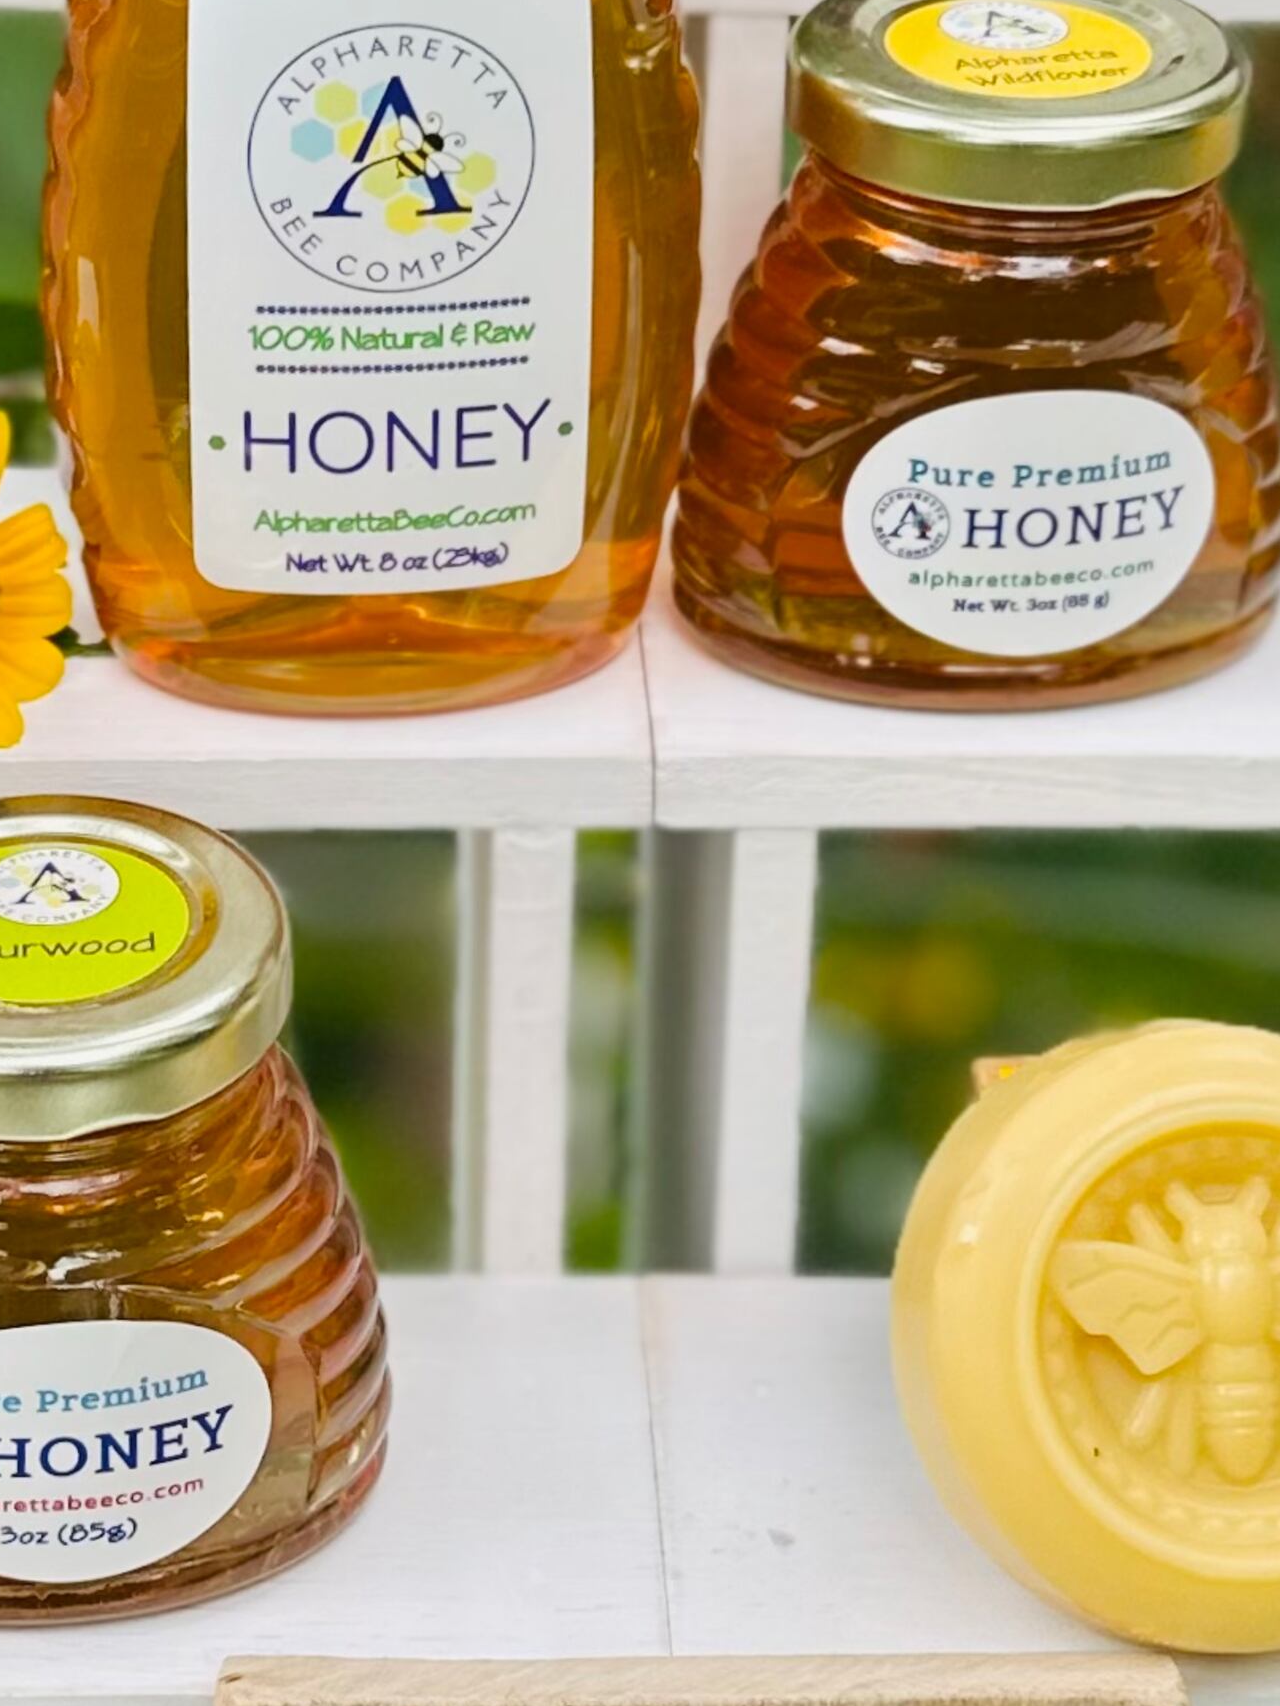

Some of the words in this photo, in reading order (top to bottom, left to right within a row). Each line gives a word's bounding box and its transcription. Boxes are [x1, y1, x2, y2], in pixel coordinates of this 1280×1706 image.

[277, 36, 508, 115] ALPHARETTA
[955, 49, 1118, 71] Alpharetta
[966, 66, 1128, 87] Wildflower
[271, 198, 322, 255] BEE
[336, 190, 511, 284] COMPANY
[248, 325, 334, 351] 100%
[341, 324, 443, 351] Natural
[450, 322, 468, 345] &
[475, 320, 535, 345] Raw
[244, 398, 551, 474] HONEY
[908, 458, 995, 488] Pure
[1013, 451, 1171, 488] Premium
[254, 502, 535, 537] AlpharettaBeeCo.com
[961, 485, 1185, 549] HONEY
[286, 553, 327, 572] Net
[379, 552, 397, 571] 8
[403, 555, 428, 571] oz
[909, 558, 1155, 590] alpharettabeeco.com
[37, 1369, 208, 1413] Premium
[0, 1526, 49, 1544] 3oz
[58, 1518, 137, 1546] (85g)
